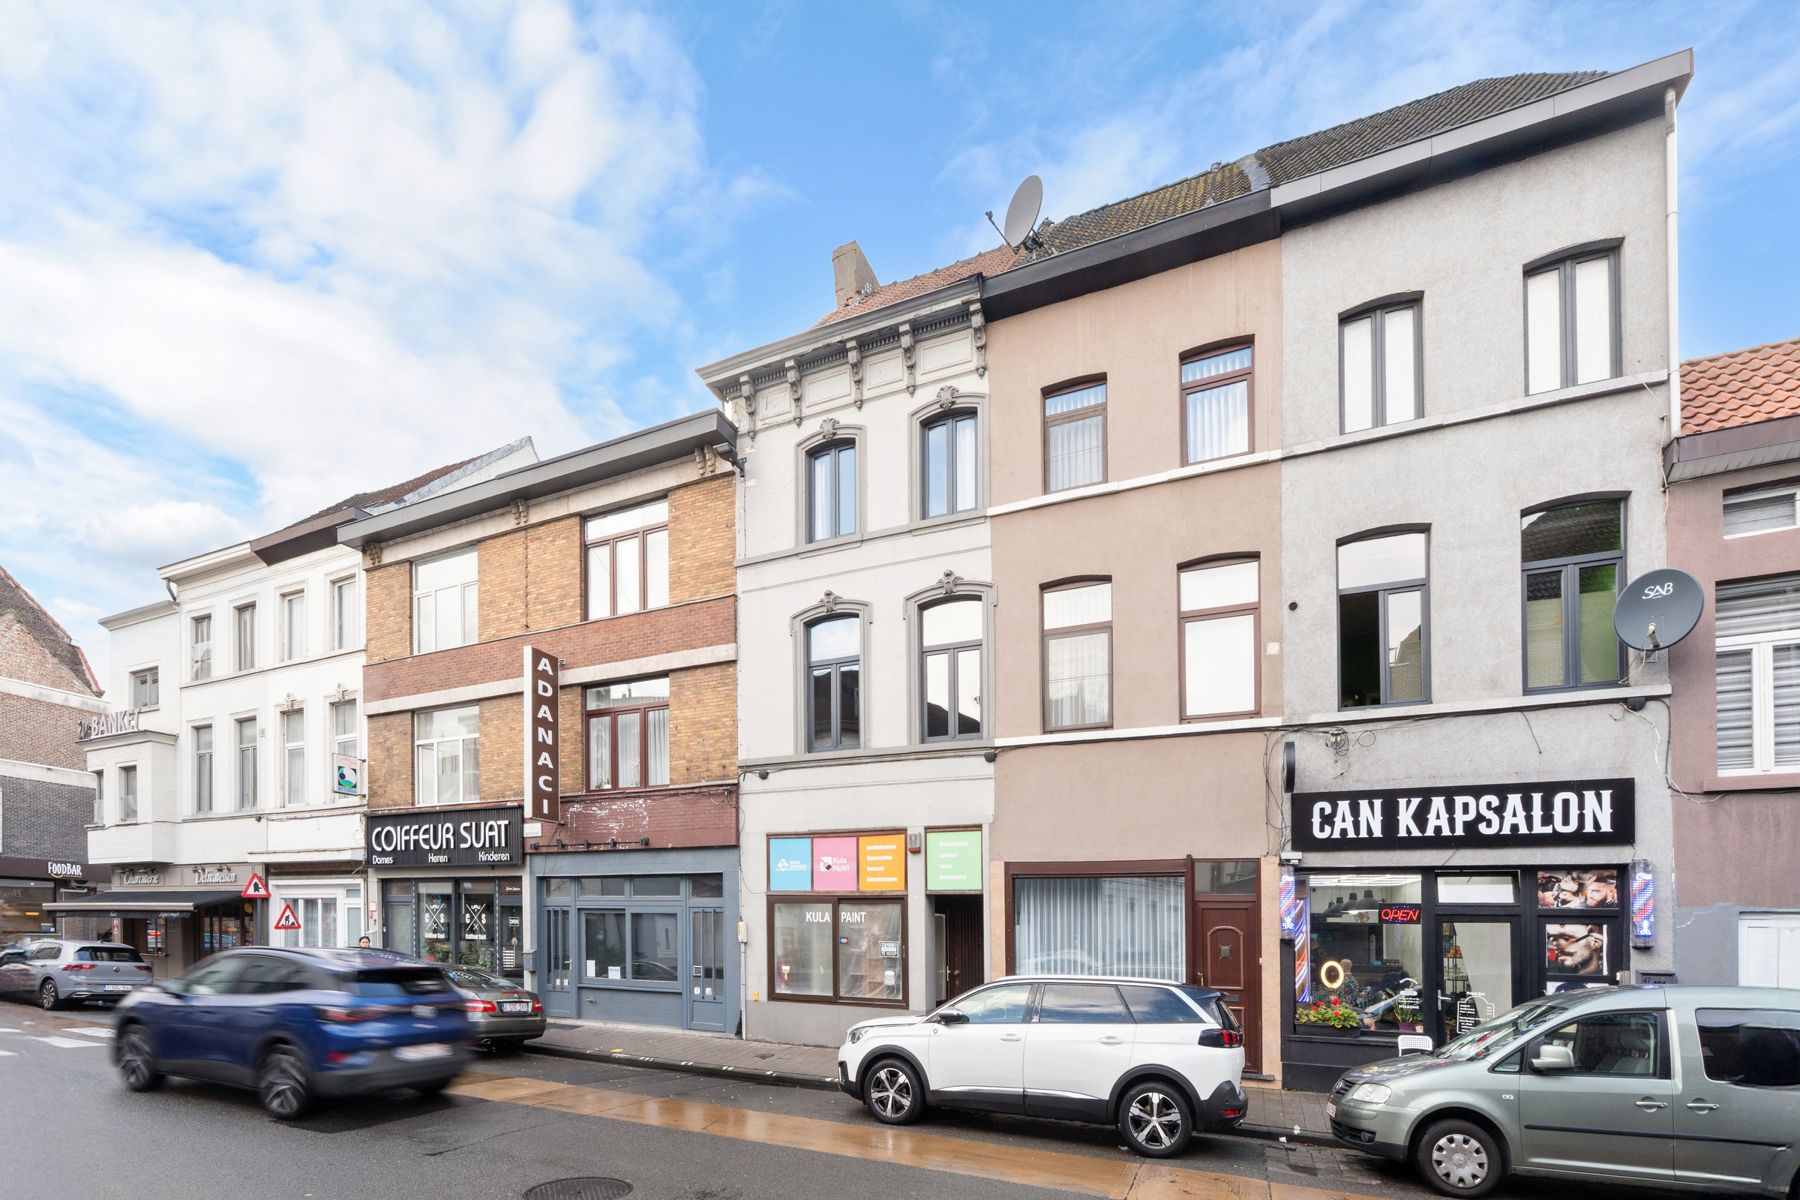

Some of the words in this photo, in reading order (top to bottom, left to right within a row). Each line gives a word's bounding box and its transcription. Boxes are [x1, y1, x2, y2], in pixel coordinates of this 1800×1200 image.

[1641, 582, 1674, 599] SAB
[537, 657, 554, 815] ADANACI
[1311, 798, 1384, 839] CAN
[1396, 789, 1614, 837] KAPSALON
[371, 825, 455, 852] COIFFEUR
[459, 820, 510, 849] SUAT
[372, 854, 394, 865] Dames
[428, 852, 449, 863] Heren
[478, 850, 511, 862] Kinderen
[832, 856, 847, 864] Kula
[47, 861, 83, 876] FOODBAR
[806, 911, 831, 923] KULA
[841, 911, 867, 923] PAINT
[1381, 908, 1420, 921] OPEN
